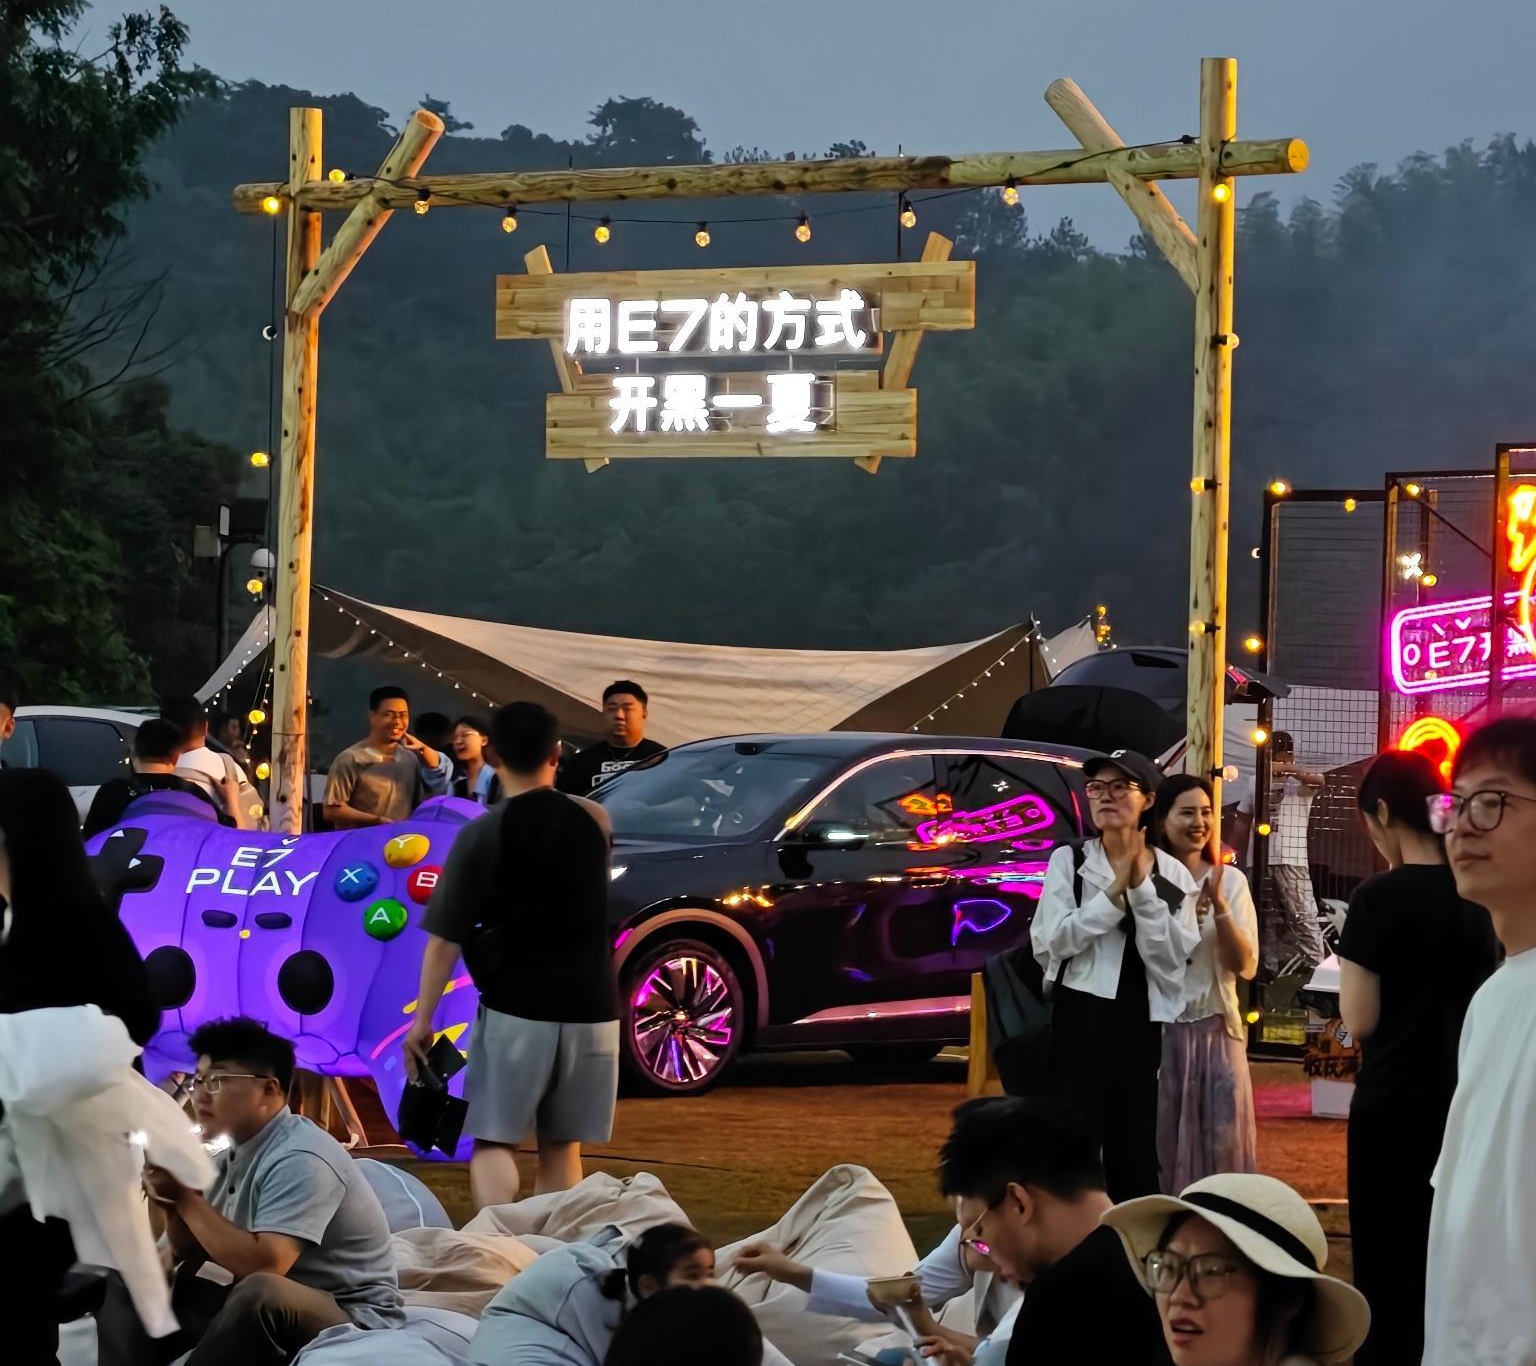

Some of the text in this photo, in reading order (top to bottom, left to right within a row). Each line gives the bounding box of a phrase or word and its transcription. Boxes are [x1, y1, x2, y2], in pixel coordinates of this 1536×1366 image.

[565, 288, 867, 355] 用E7的方式
[608, 373, 818, 434] 开黑一夏
[392, 836, 416, 849] Y
[231, 846, 295, 868] E7
[185, 868, 320, 896] PLAY
[339, 868, 364, 884] X
[416, 871, 439, 888] B
[369, 907, 391, 925] A
